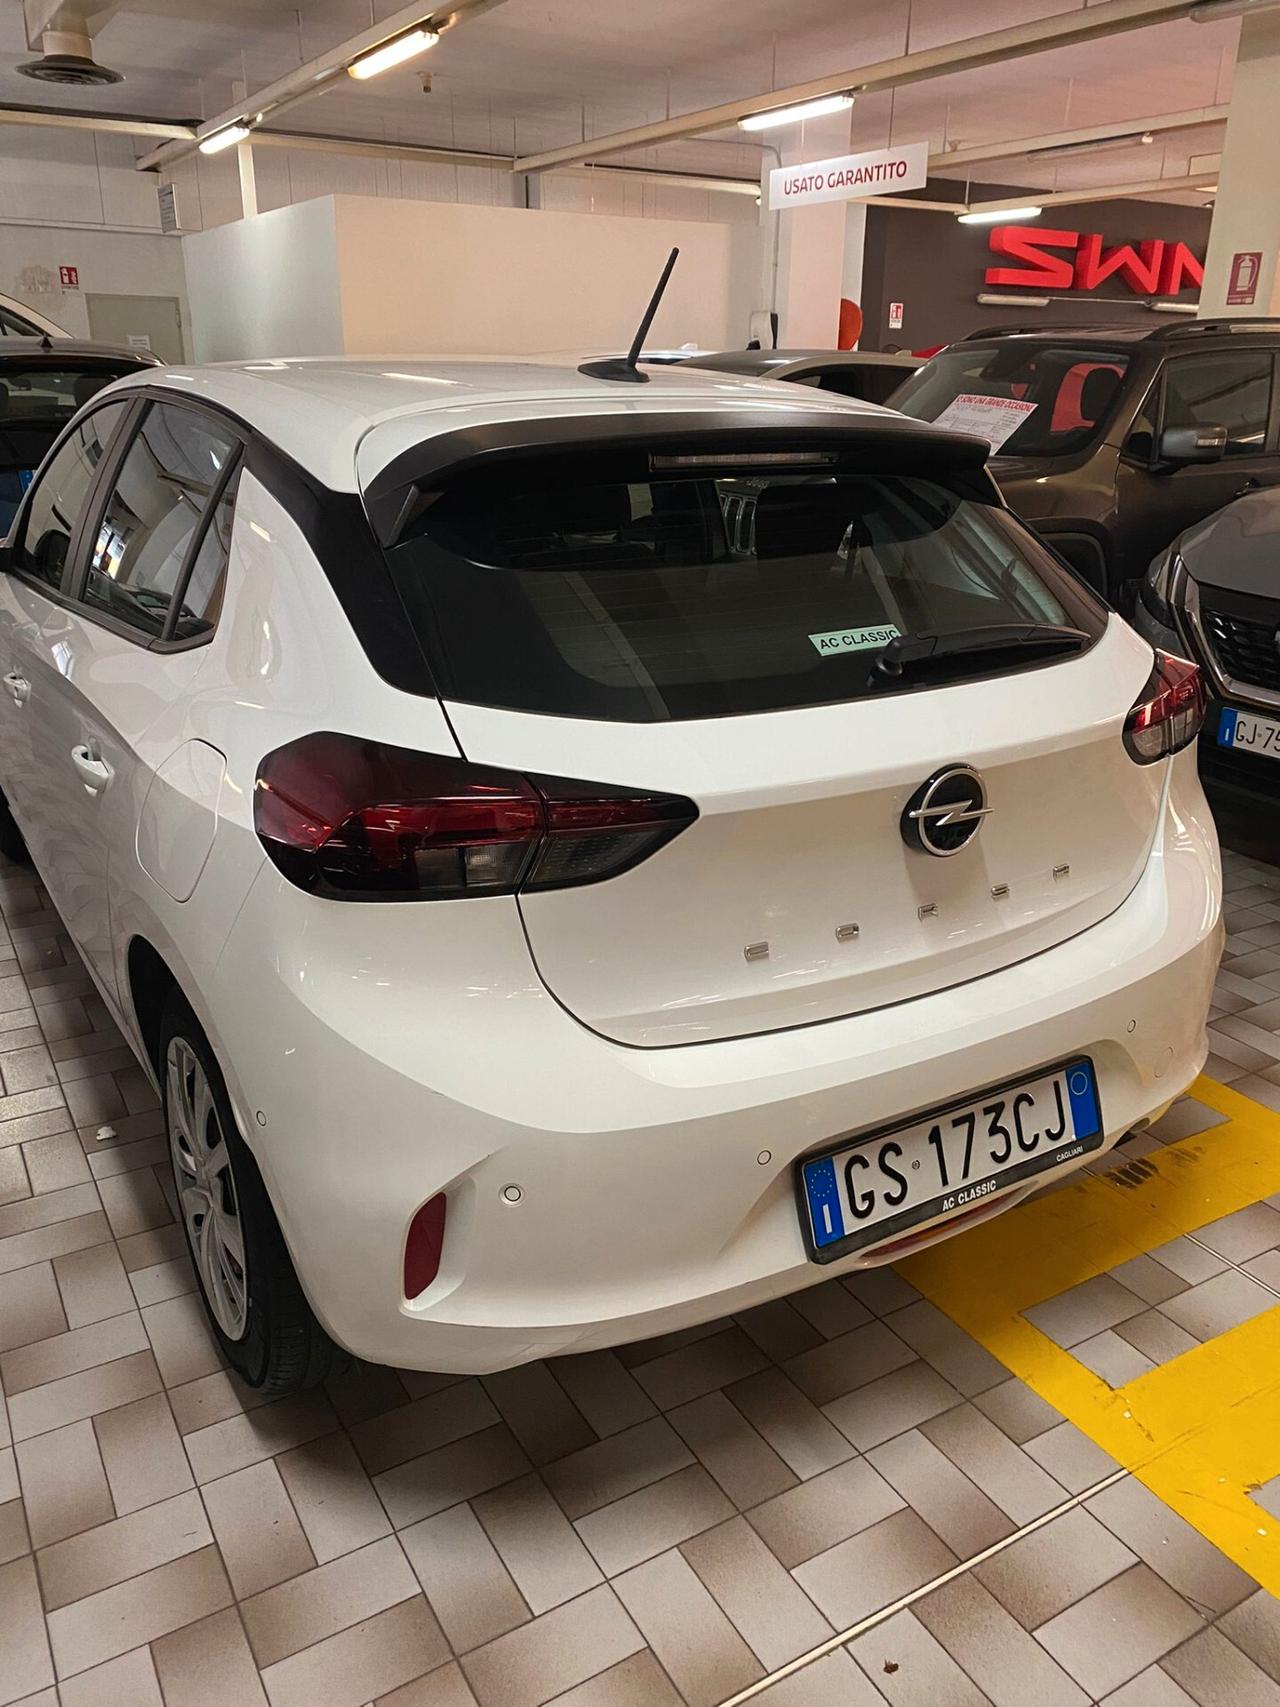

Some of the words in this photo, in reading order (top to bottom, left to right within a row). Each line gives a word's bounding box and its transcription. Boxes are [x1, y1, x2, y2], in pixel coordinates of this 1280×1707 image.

[784, 174, 824, 195] USATO
[827, 160, 907, 188] GARANTITO
[820, 637, 840, 650] AC
[842, 629, 898, 646] CLASSIC
[1236, 720, 1257, 744] GJ
[1056, 1146, 1084, 1162] CAGLIARI
[942, 1197, 955, 1212] AC
[957, 1180, 997, 1205] CLASSIC
[822, 1203, 833, 1234] I
